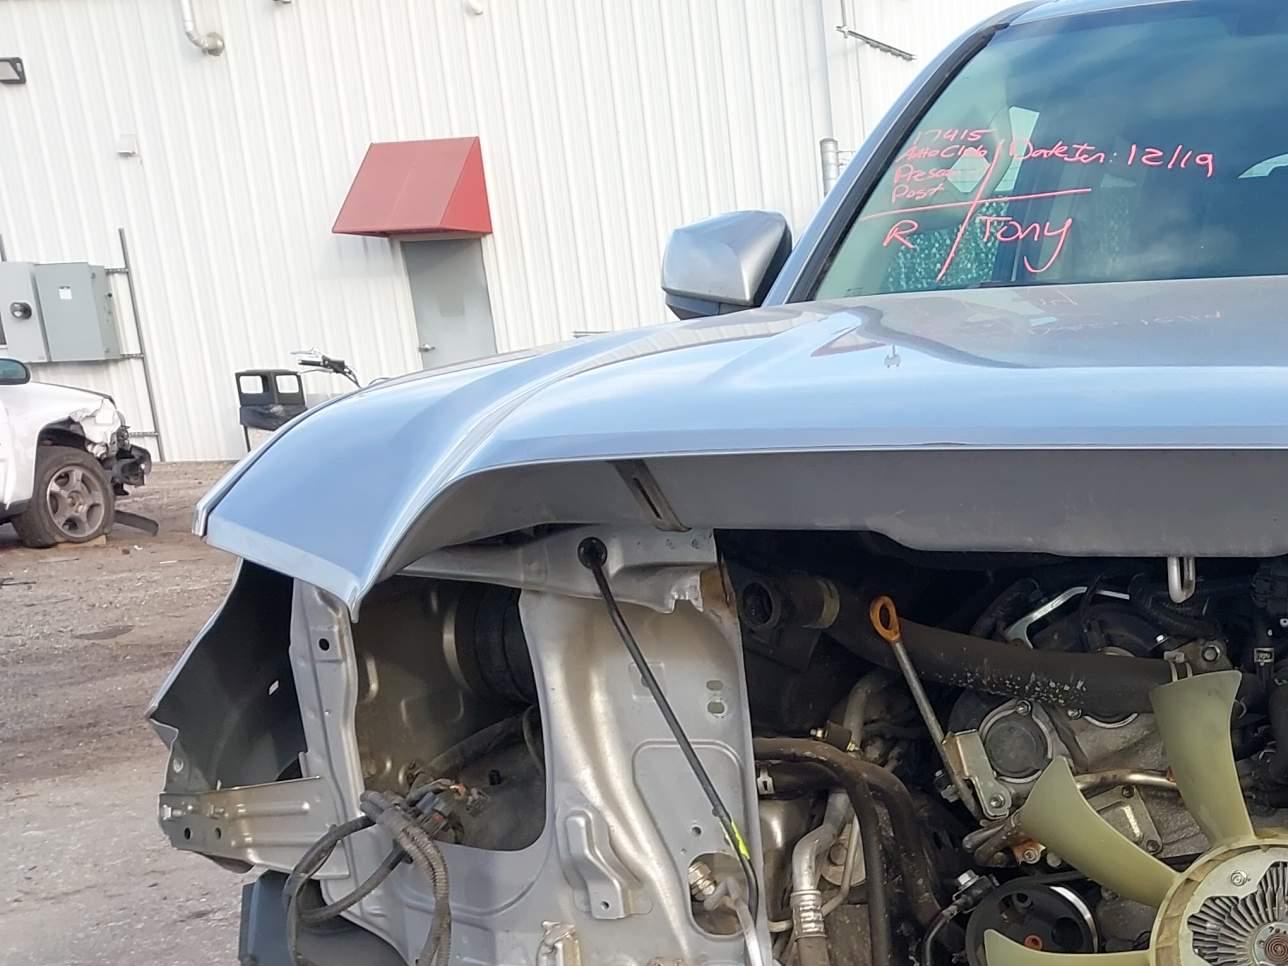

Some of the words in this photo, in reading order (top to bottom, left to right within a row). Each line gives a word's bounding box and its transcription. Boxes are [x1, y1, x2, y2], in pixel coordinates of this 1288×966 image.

[1128, 144, 1214, 178] 12/19
[883, 219, 920, 250] R
[976, 217, 1073, 274] Tony
